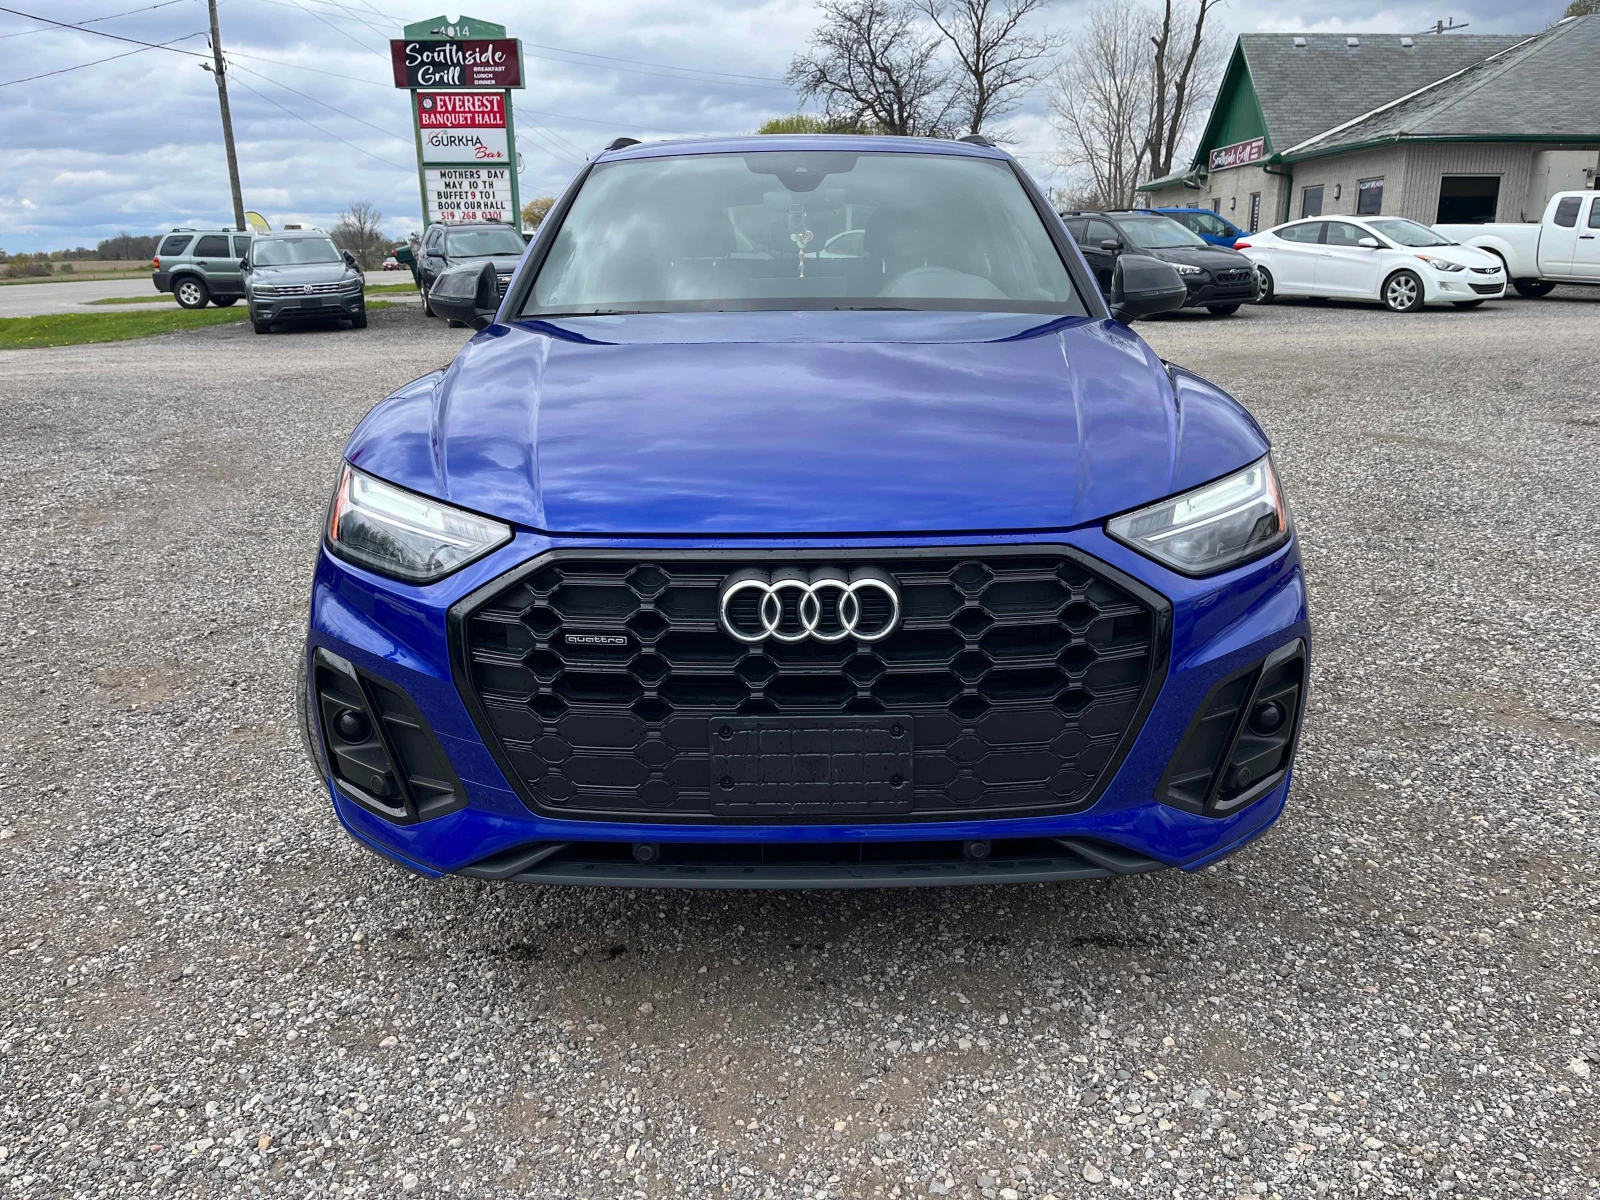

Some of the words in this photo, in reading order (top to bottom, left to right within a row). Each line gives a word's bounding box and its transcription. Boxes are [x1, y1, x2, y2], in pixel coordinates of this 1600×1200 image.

[405, 42, 506, 67] Southside
[417, 65, 460, 85] Grill
[436, 95, 500, 112] EVEREST
[422, 113, 473, 126] BANQUET
[475, 113, 503, 124] HALL
[430, 135, 483, 147] GURKHA
[474, 146, 504, 159] Bar
[440, 170, 481, 179] MOTHERS
[487, 170, 505, 179] DAY
[444, 181, 463, 189] MAY
[469, 181, 478, 189] 10
[437, 191, 469, 200] BUFFET
[470, 191, 476, 200] 9
[479, 191, 490, 200] TO
[438, 201, 462, 210] BOOK
[464, 201, 482, 210] OUR
[484, 201, 506, 210] HALL
[441, 211, 455, 220] 519
[462, 211, 477, 220] 268
[482, 211, 502, 220] 0301
[567, 636, 624, 644] quattro
